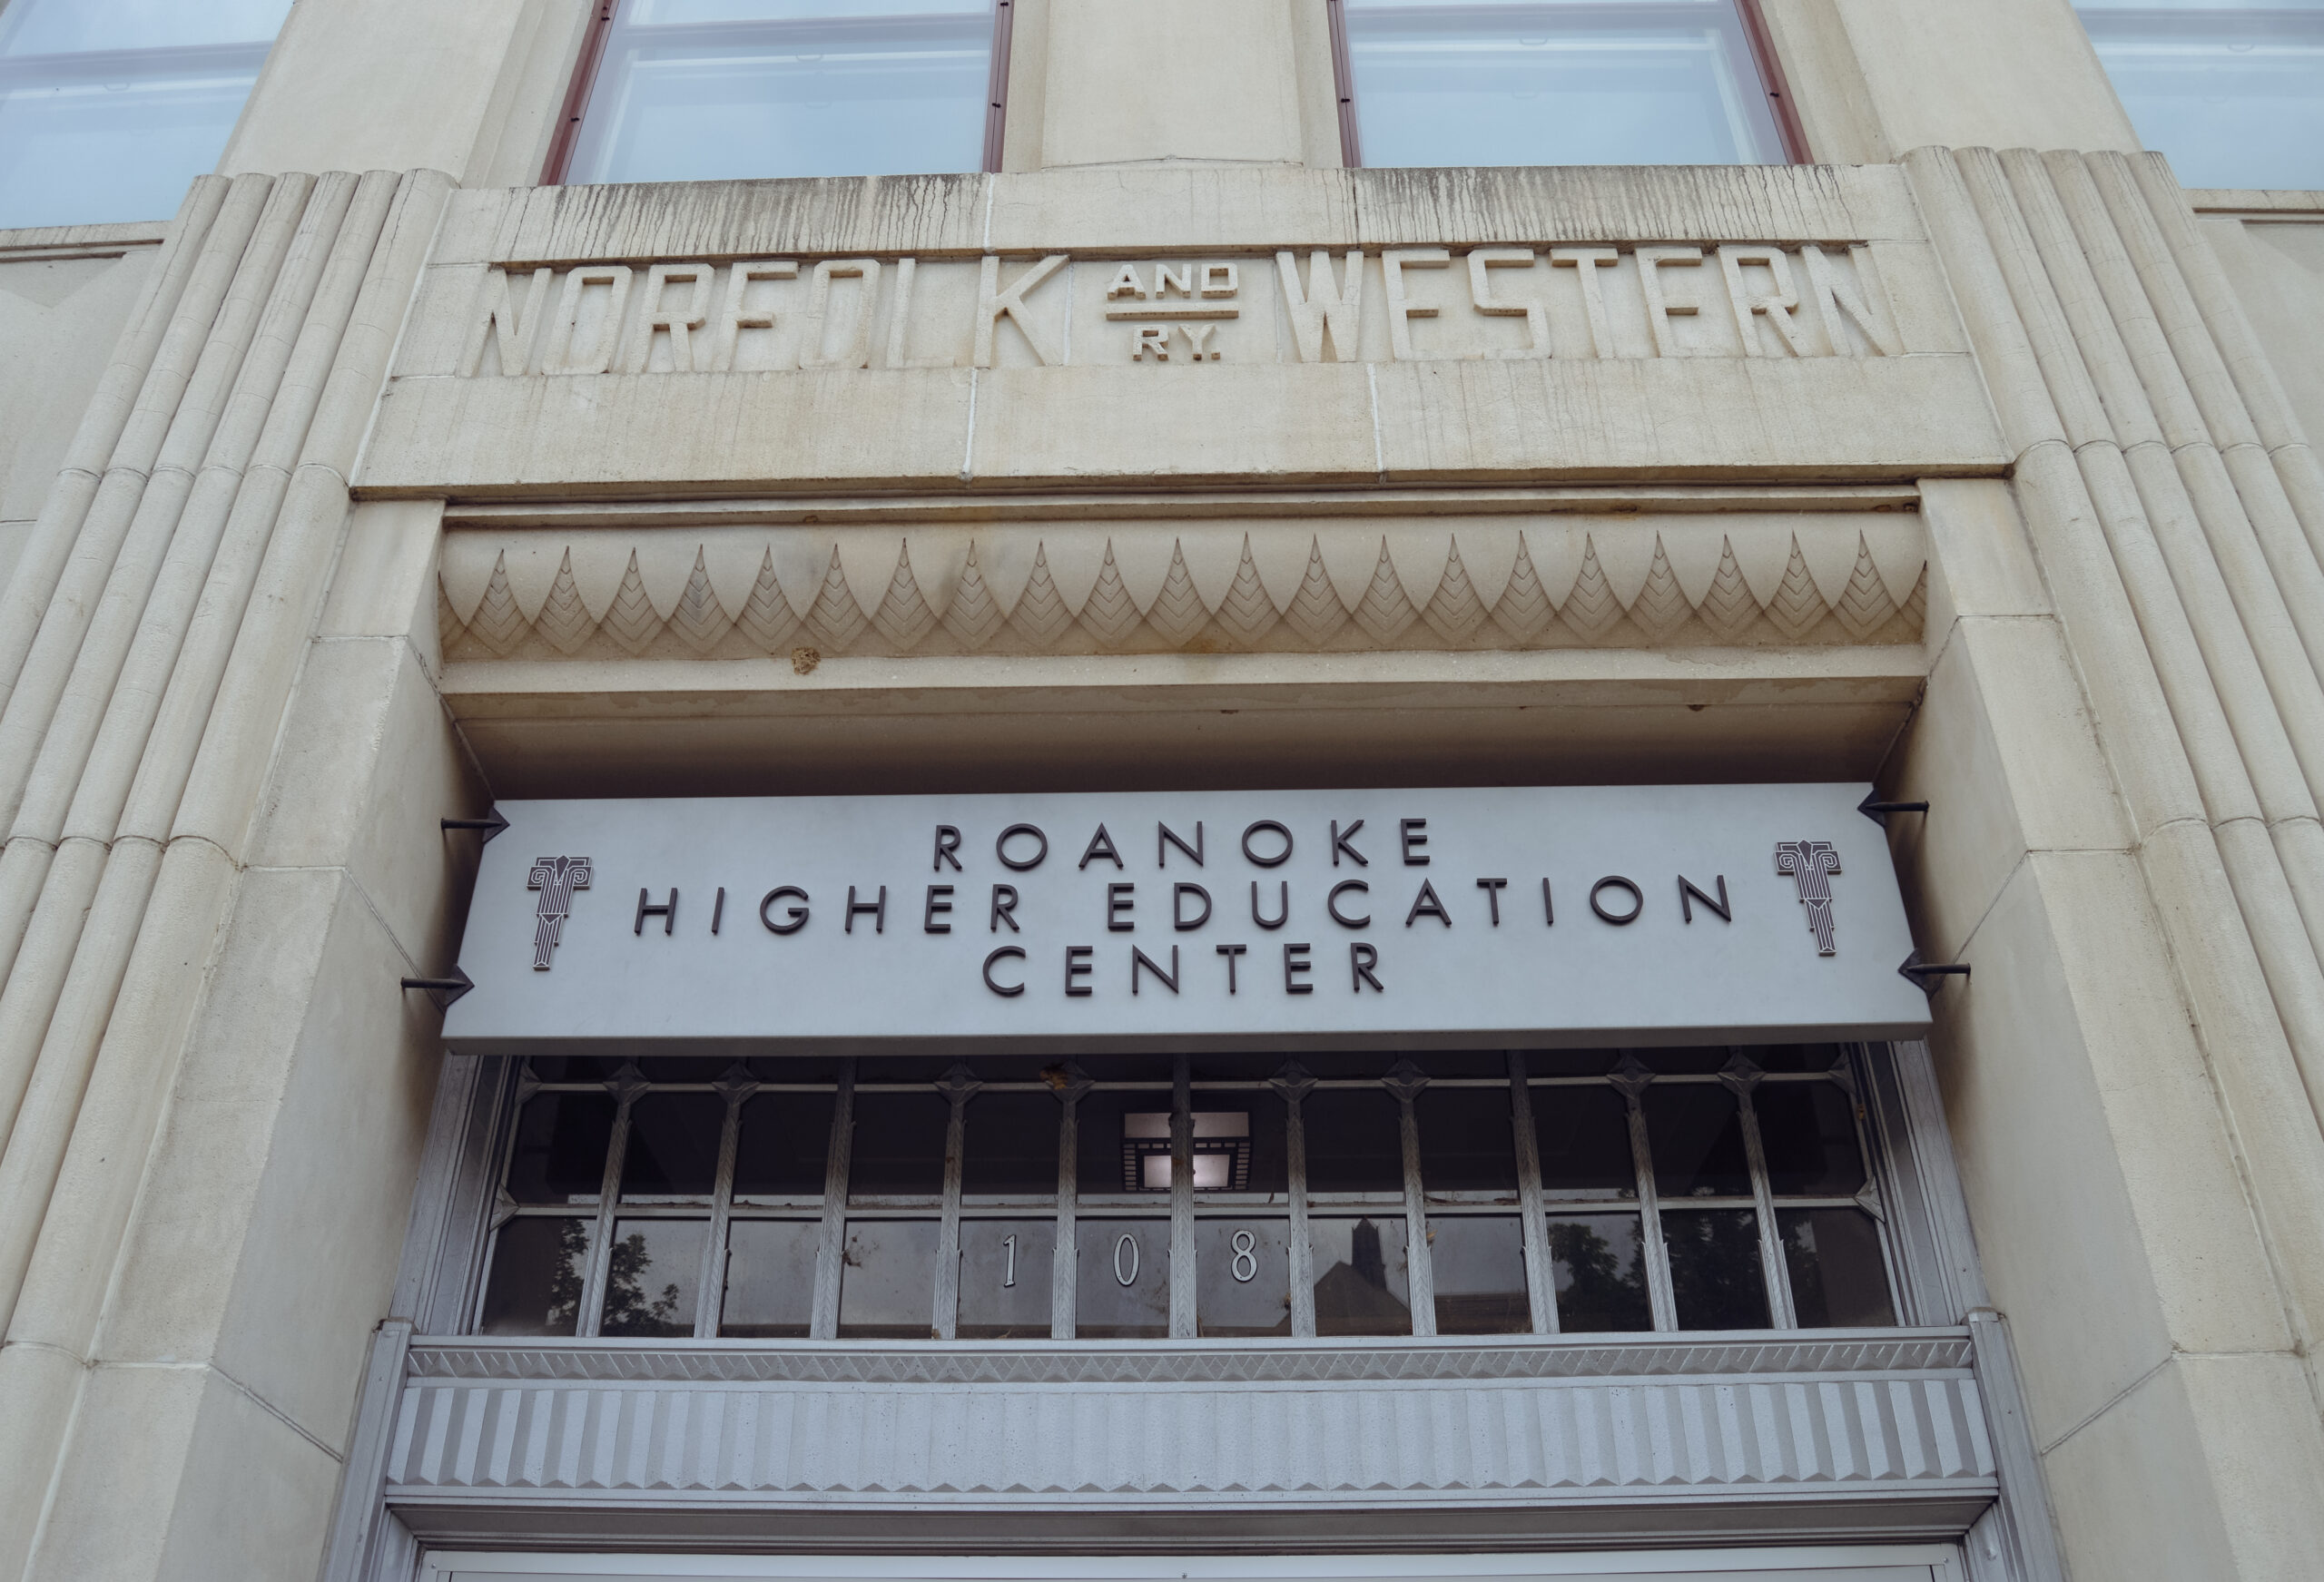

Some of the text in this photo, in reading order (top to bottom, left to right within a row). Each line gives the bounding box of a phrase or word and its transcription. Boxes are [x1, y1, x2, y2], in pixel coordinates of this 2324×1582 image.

[454, 244, 1906, 378] NORFOLK AND WESTERN
[933, 818, 1431, 871] ROANOKE
[634, 875, 1732, 935] HIGHER EDUCATION
[982, 942, 1384, 997] CENTER
[1002, 1229, 1258, 1288] 108
